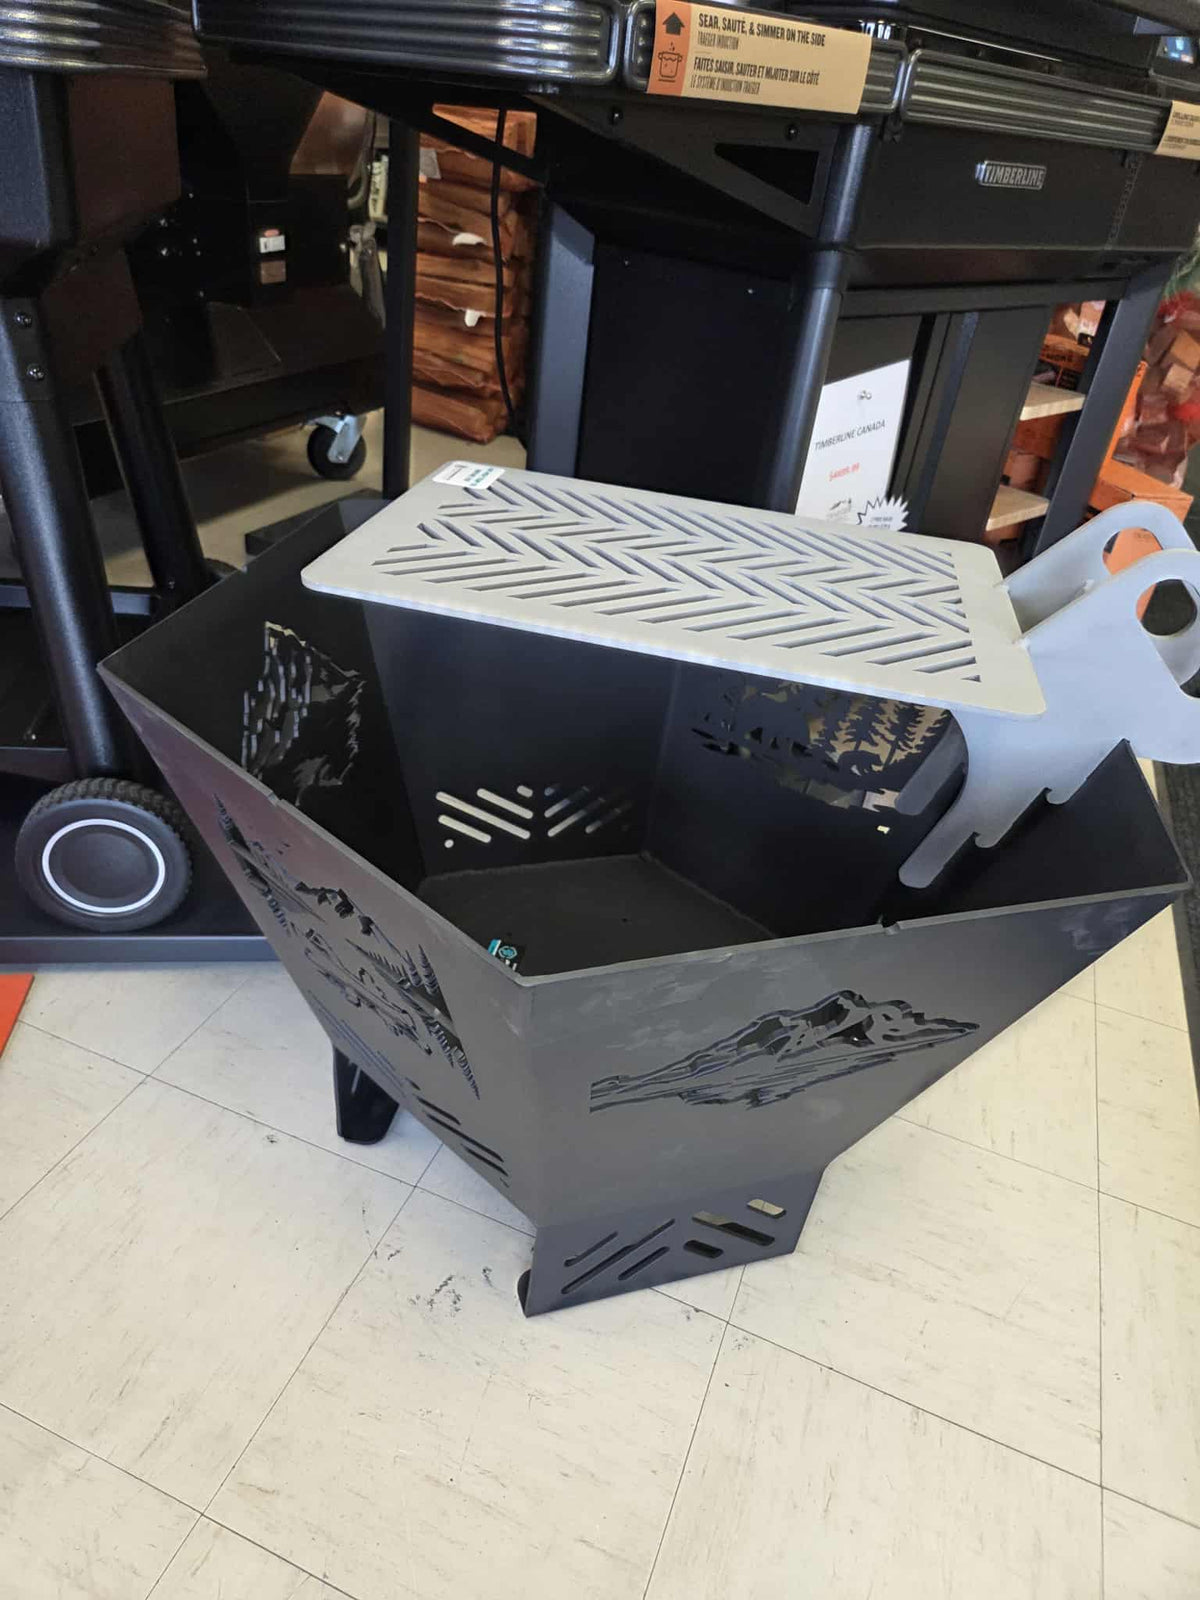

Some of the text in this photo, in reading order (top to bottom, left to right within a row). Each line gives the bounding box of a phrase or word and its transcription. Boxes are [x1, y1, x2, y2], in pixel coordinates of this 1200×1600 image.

[698, 12, 721, 31] SEAR,
[748, 21, 755, 36] &
[756, 22, 785, 40] SIMMER
[786, 28, 796, 42] ON
[797, 29, 810, 44] THE
[811, 32, 826, 47] SIDE
[693, 56, 714, 72] FAITES
[735, 62, 757, 77] SAUTER
[756, 65, 766, 78] ET
[788, 70, 800, 83] SUR
[799, 71, 807, 84] LE
[984, 164, 1044, 186] TIMBERLINE
[814, 419, 885, 450] TIMBERLINE CANADA
